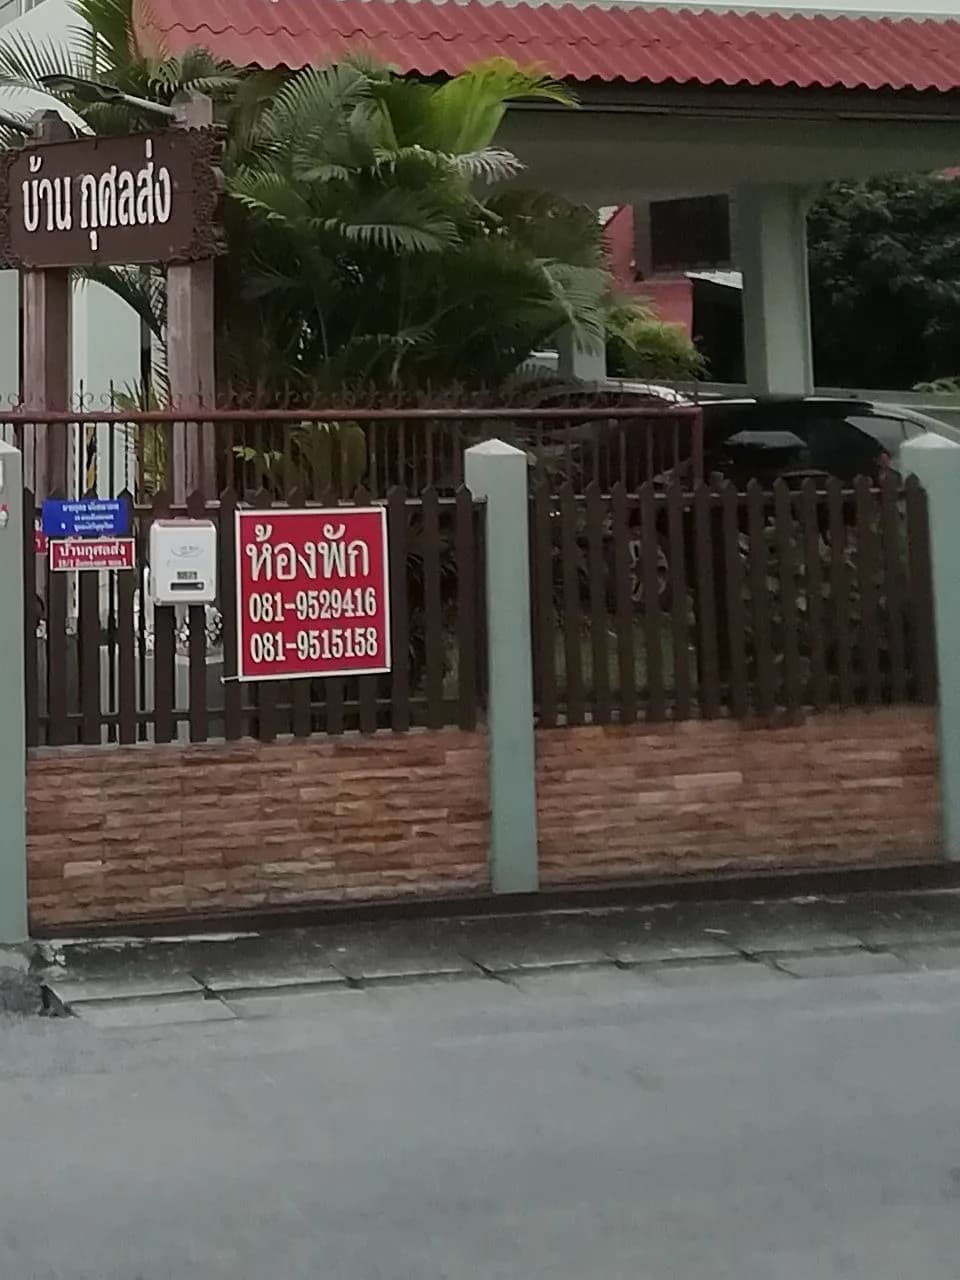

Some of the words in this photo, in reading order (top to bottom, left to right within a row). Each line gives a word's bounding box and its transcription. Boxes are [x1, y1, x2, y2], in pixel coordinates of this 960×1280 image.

[22, 155, 72, 232] บ้าน
[80, 138, 172, 251] กุศลส่ง
[245, 523, 370, 582] ห้องพัก
[248, 586, 377, 623] 081-9529416
[250, 626, 378, 664] 081-9515158
